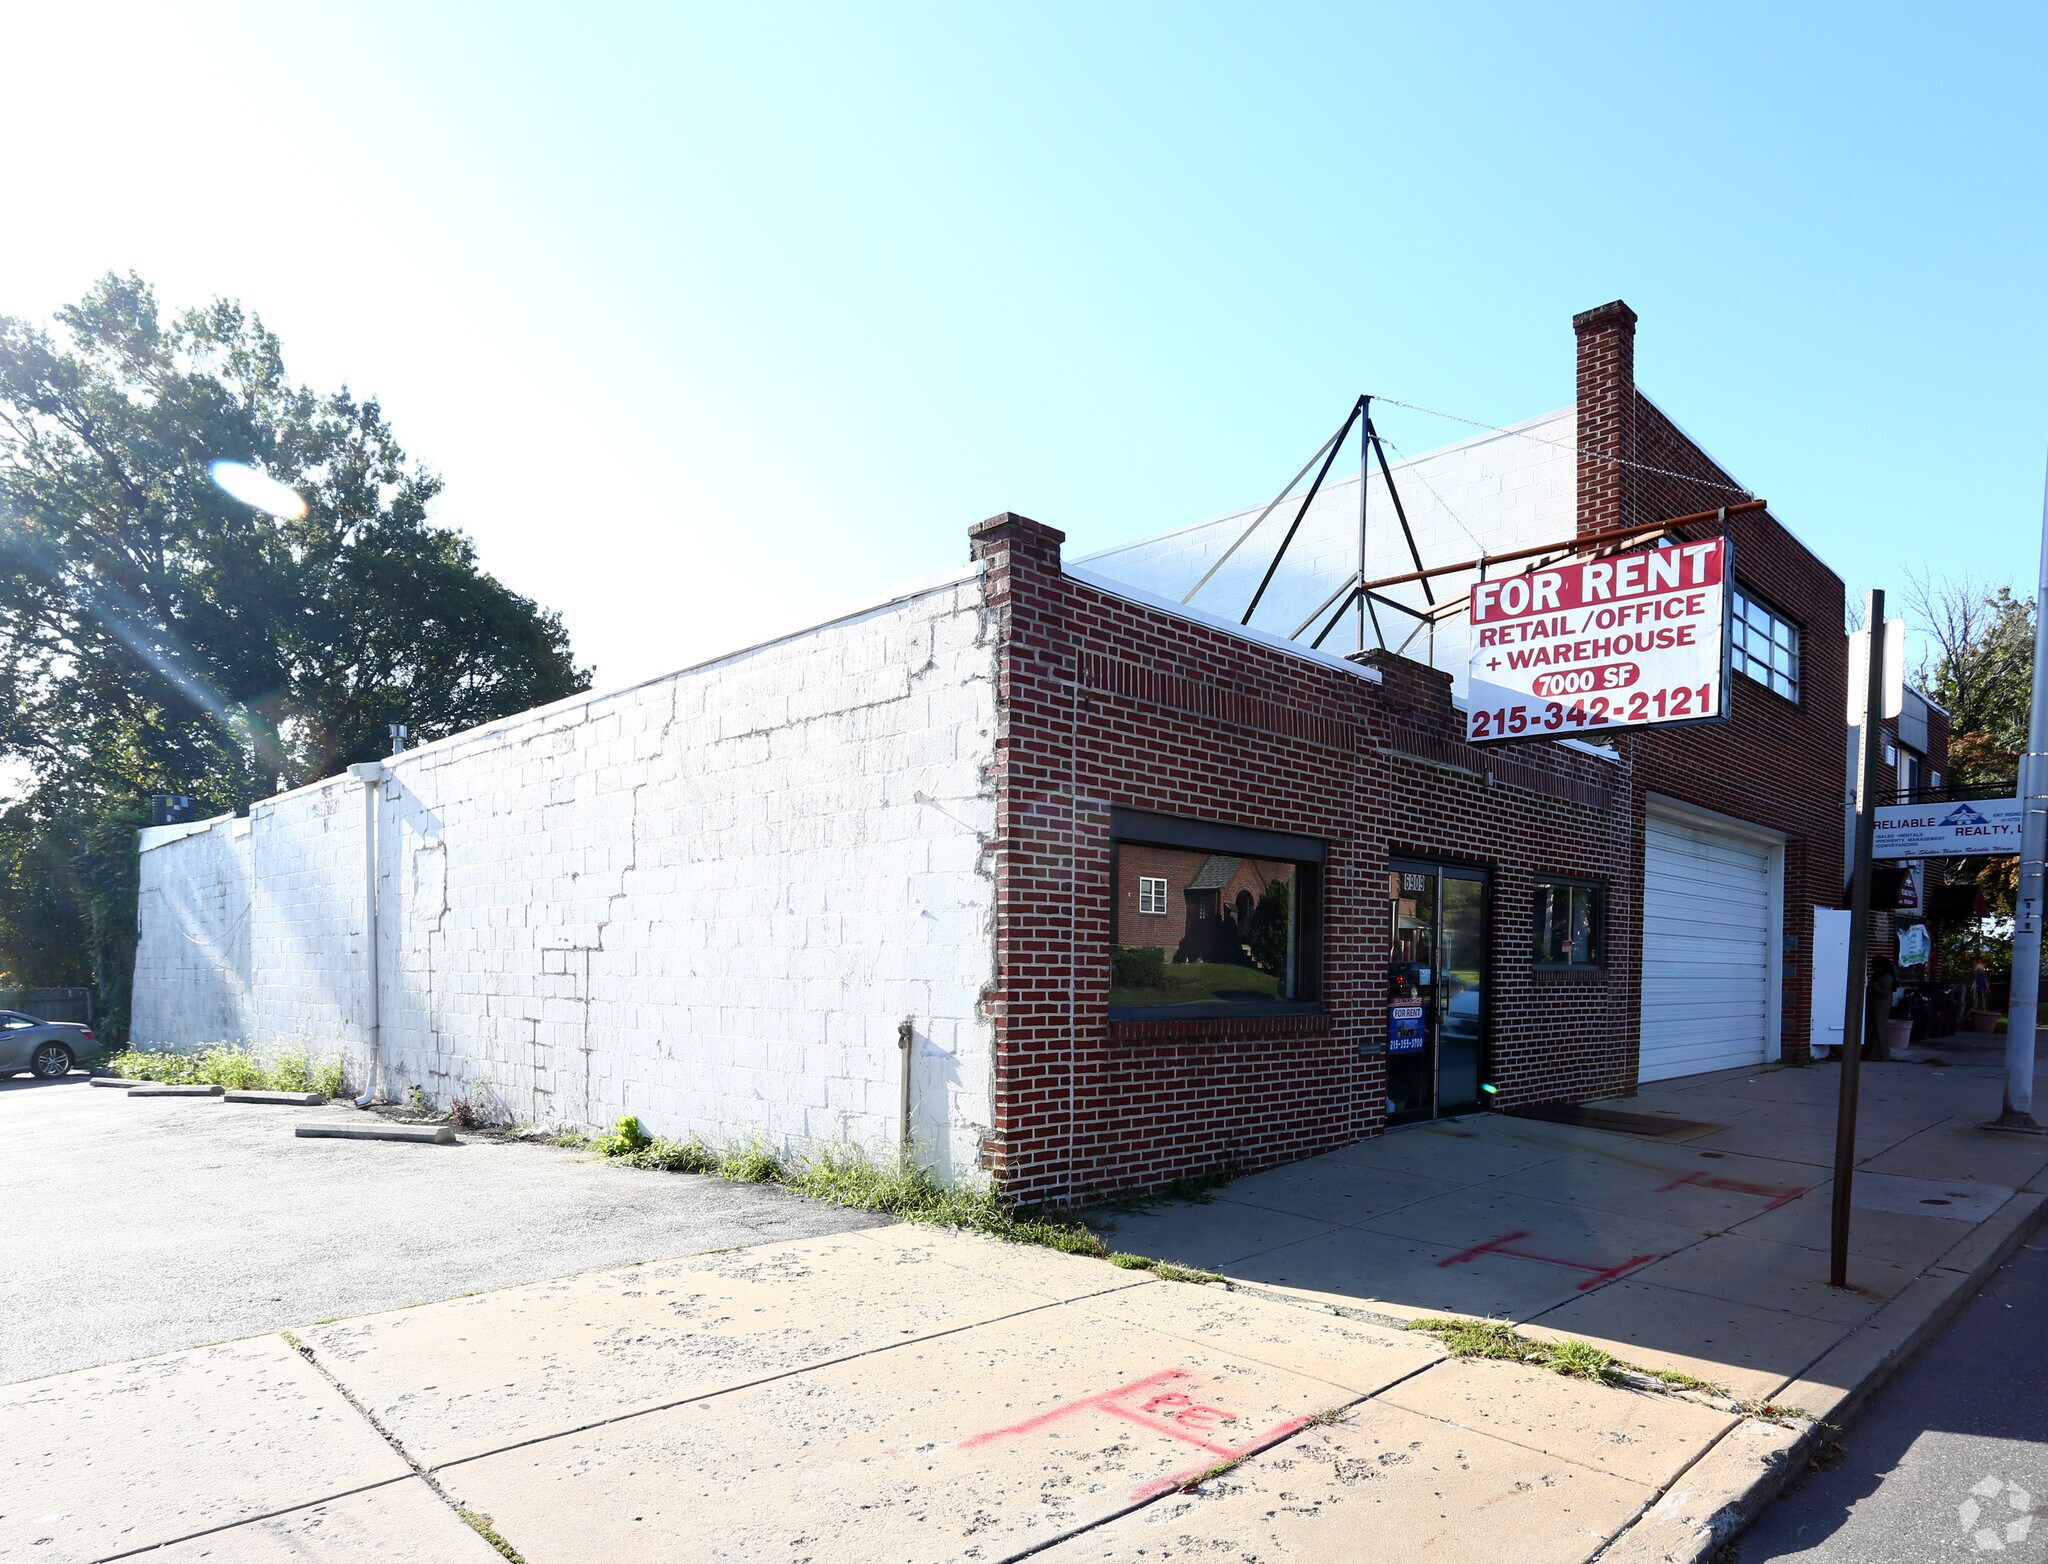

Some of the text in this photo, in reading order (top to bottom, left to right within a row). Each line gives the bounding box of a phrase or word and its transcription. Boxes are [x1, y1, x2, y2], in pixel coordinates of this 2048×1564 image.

[1475, 542, 1717, 621] FOR RENT
[1479, 616, 1576, 648] RETAIL
[1506, 624, 1697, 670] WAREHOUSE
[1538, 664, 1634, 696] 7000 SF
[1471, 683, 1711, 738] 215-342-2121
[1874, 817, 1936, 829] RELIABLE
[1955, 825, 2014, 836] REALTY,
[1405, 874, 1425, 891] 6909
[1394, 1008, 1421, 1018] FOR RENT
